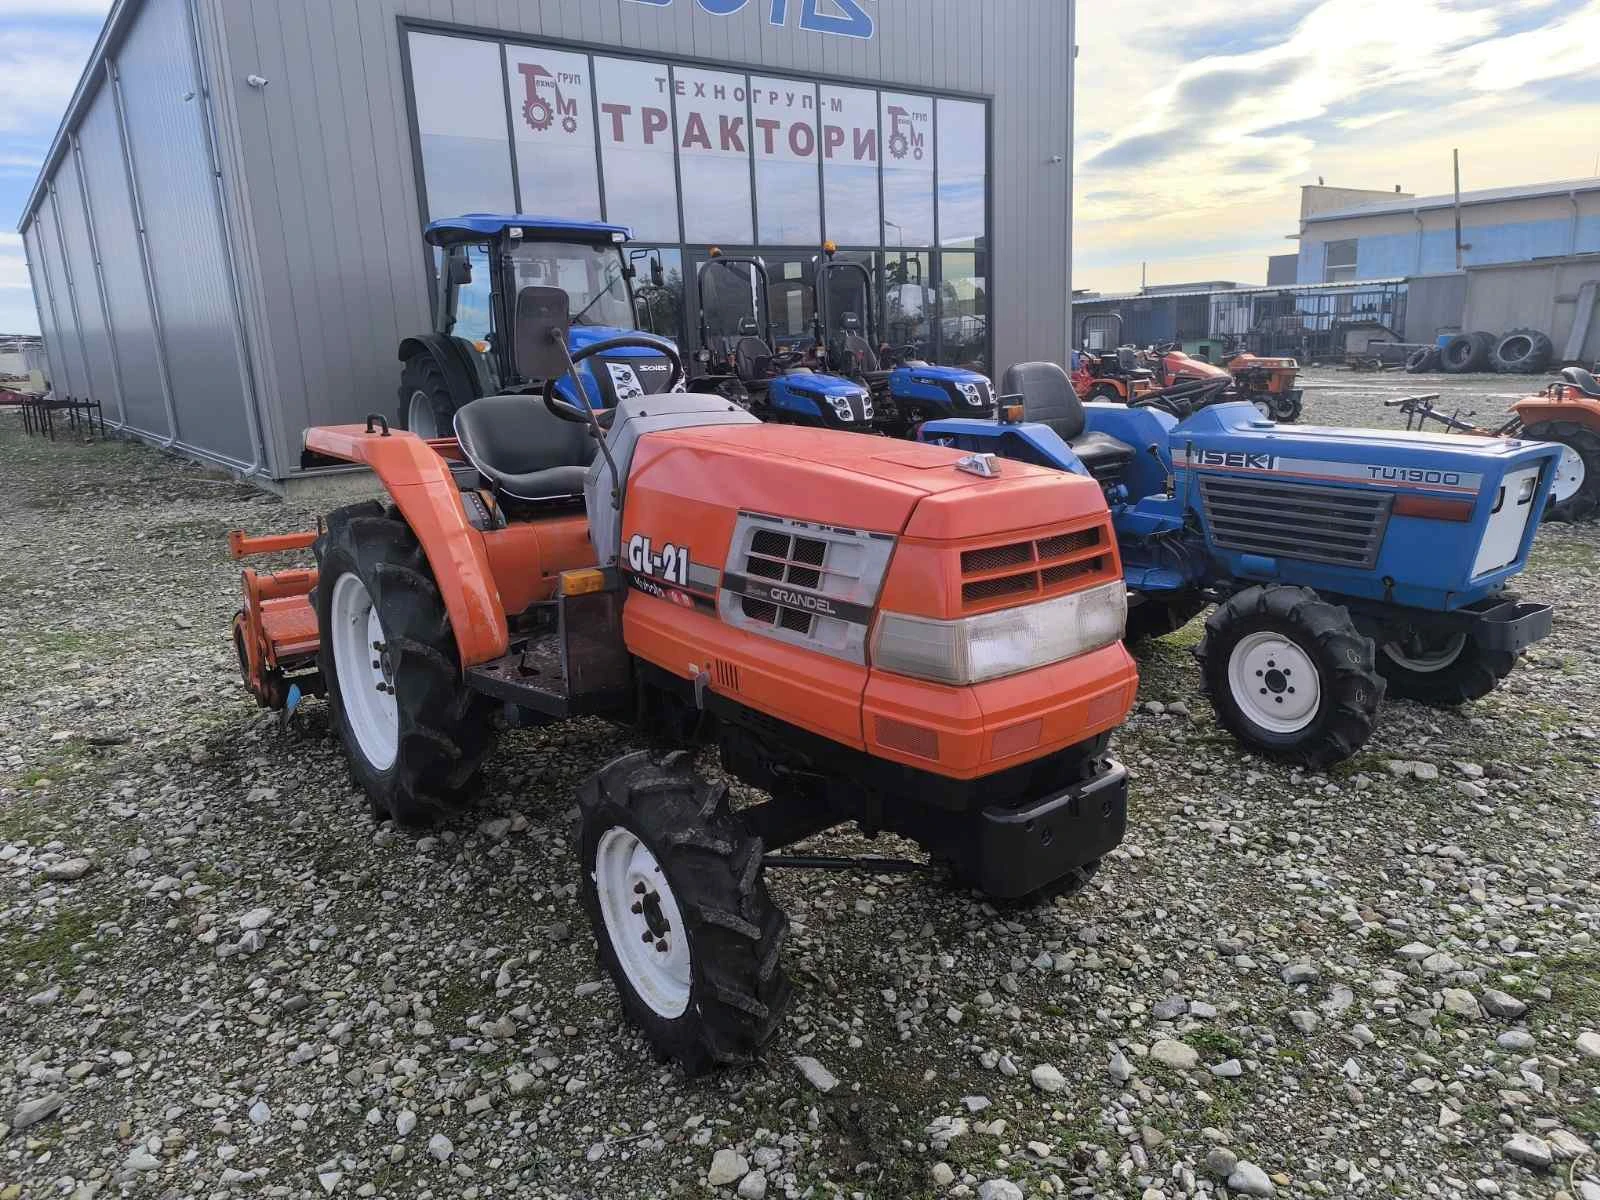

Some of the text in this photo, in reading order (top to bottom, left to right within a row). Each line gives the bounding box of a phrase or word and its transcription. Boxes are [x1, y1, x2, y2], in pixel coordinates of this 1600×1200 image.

[557, 72, 581, 85] ГРУП
[654, 77, 843, 113] ТЕХНОГРУП-М
[601, 103, 877, 161] ТРАКТОРИ
[1198, 449, 1275, 470] ISEKI
[1367, 465, 1460, 486] TU1900
[628, 533, 689, 588] GL-21
[770, 588, 836, 615] GRANDEL
